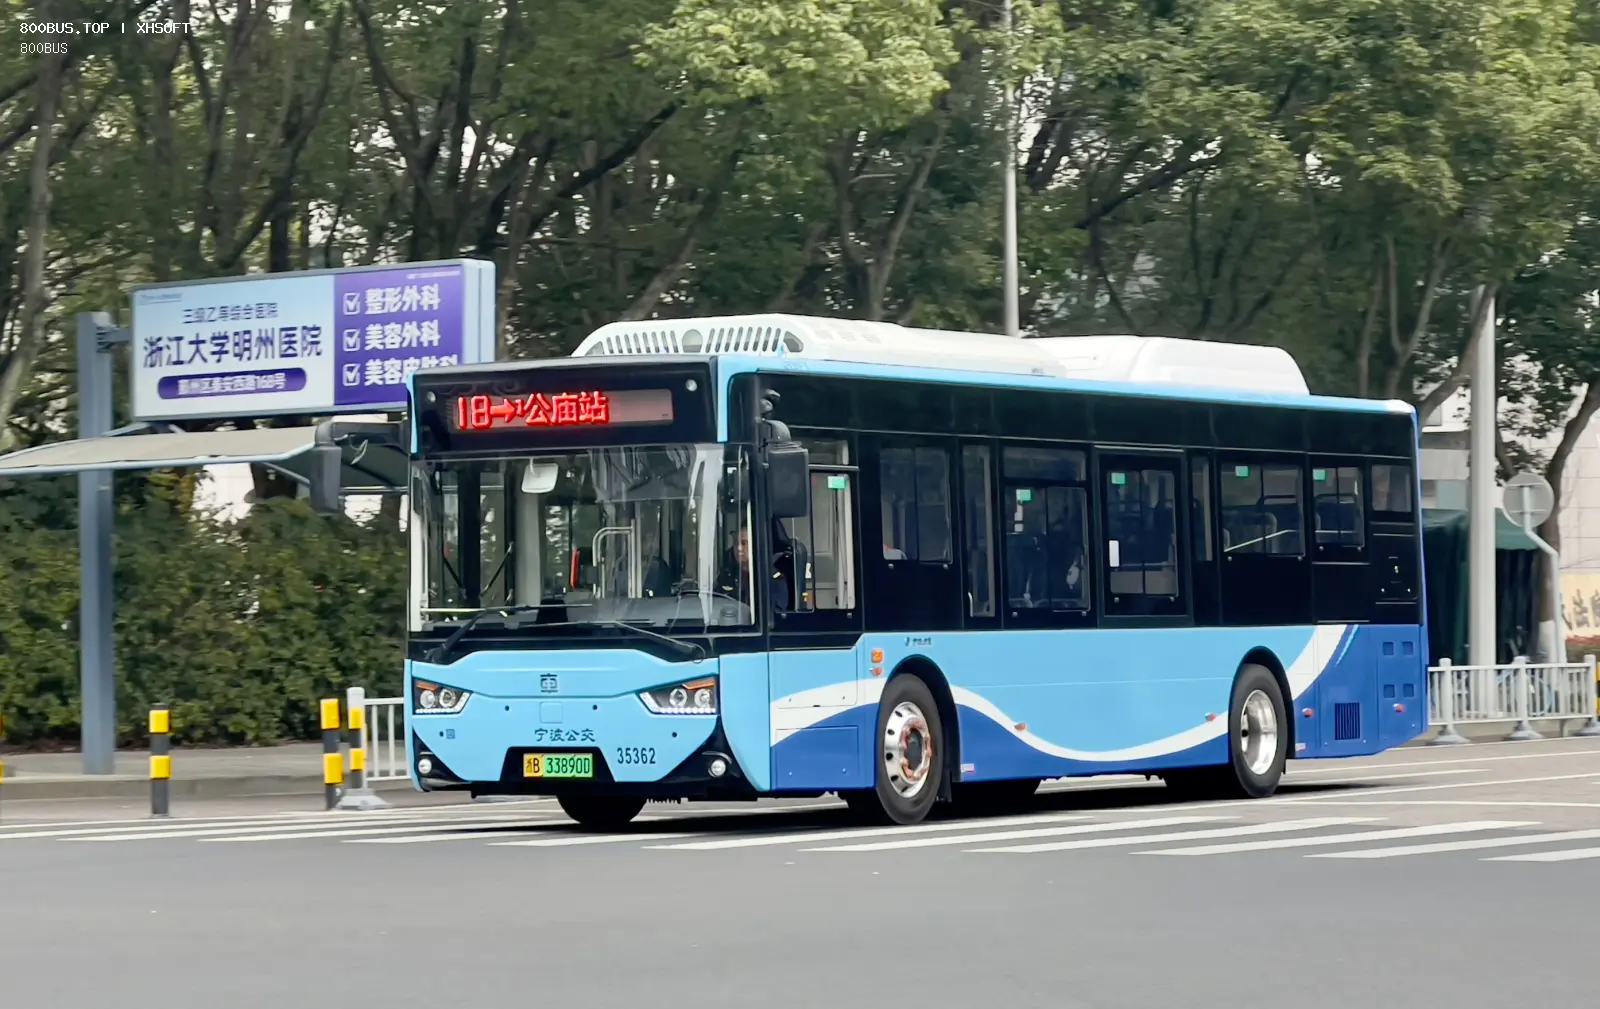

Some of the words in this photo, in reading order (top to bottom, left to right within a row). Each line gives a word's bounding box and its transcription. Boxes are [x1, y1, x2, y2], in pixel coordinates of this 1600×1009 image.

[364, 283, 441, 315] 整形外科
[143, 323, 323, 368] 浙江大学明州医院
[364, 319, 441, 351] 美容外科
[458, 395, 491, 429] 18
[515, 390, 608, 425] 公庙站
[534, 728, 596, 742] 宁波公交
[616, 747, 656, 764] 35362
